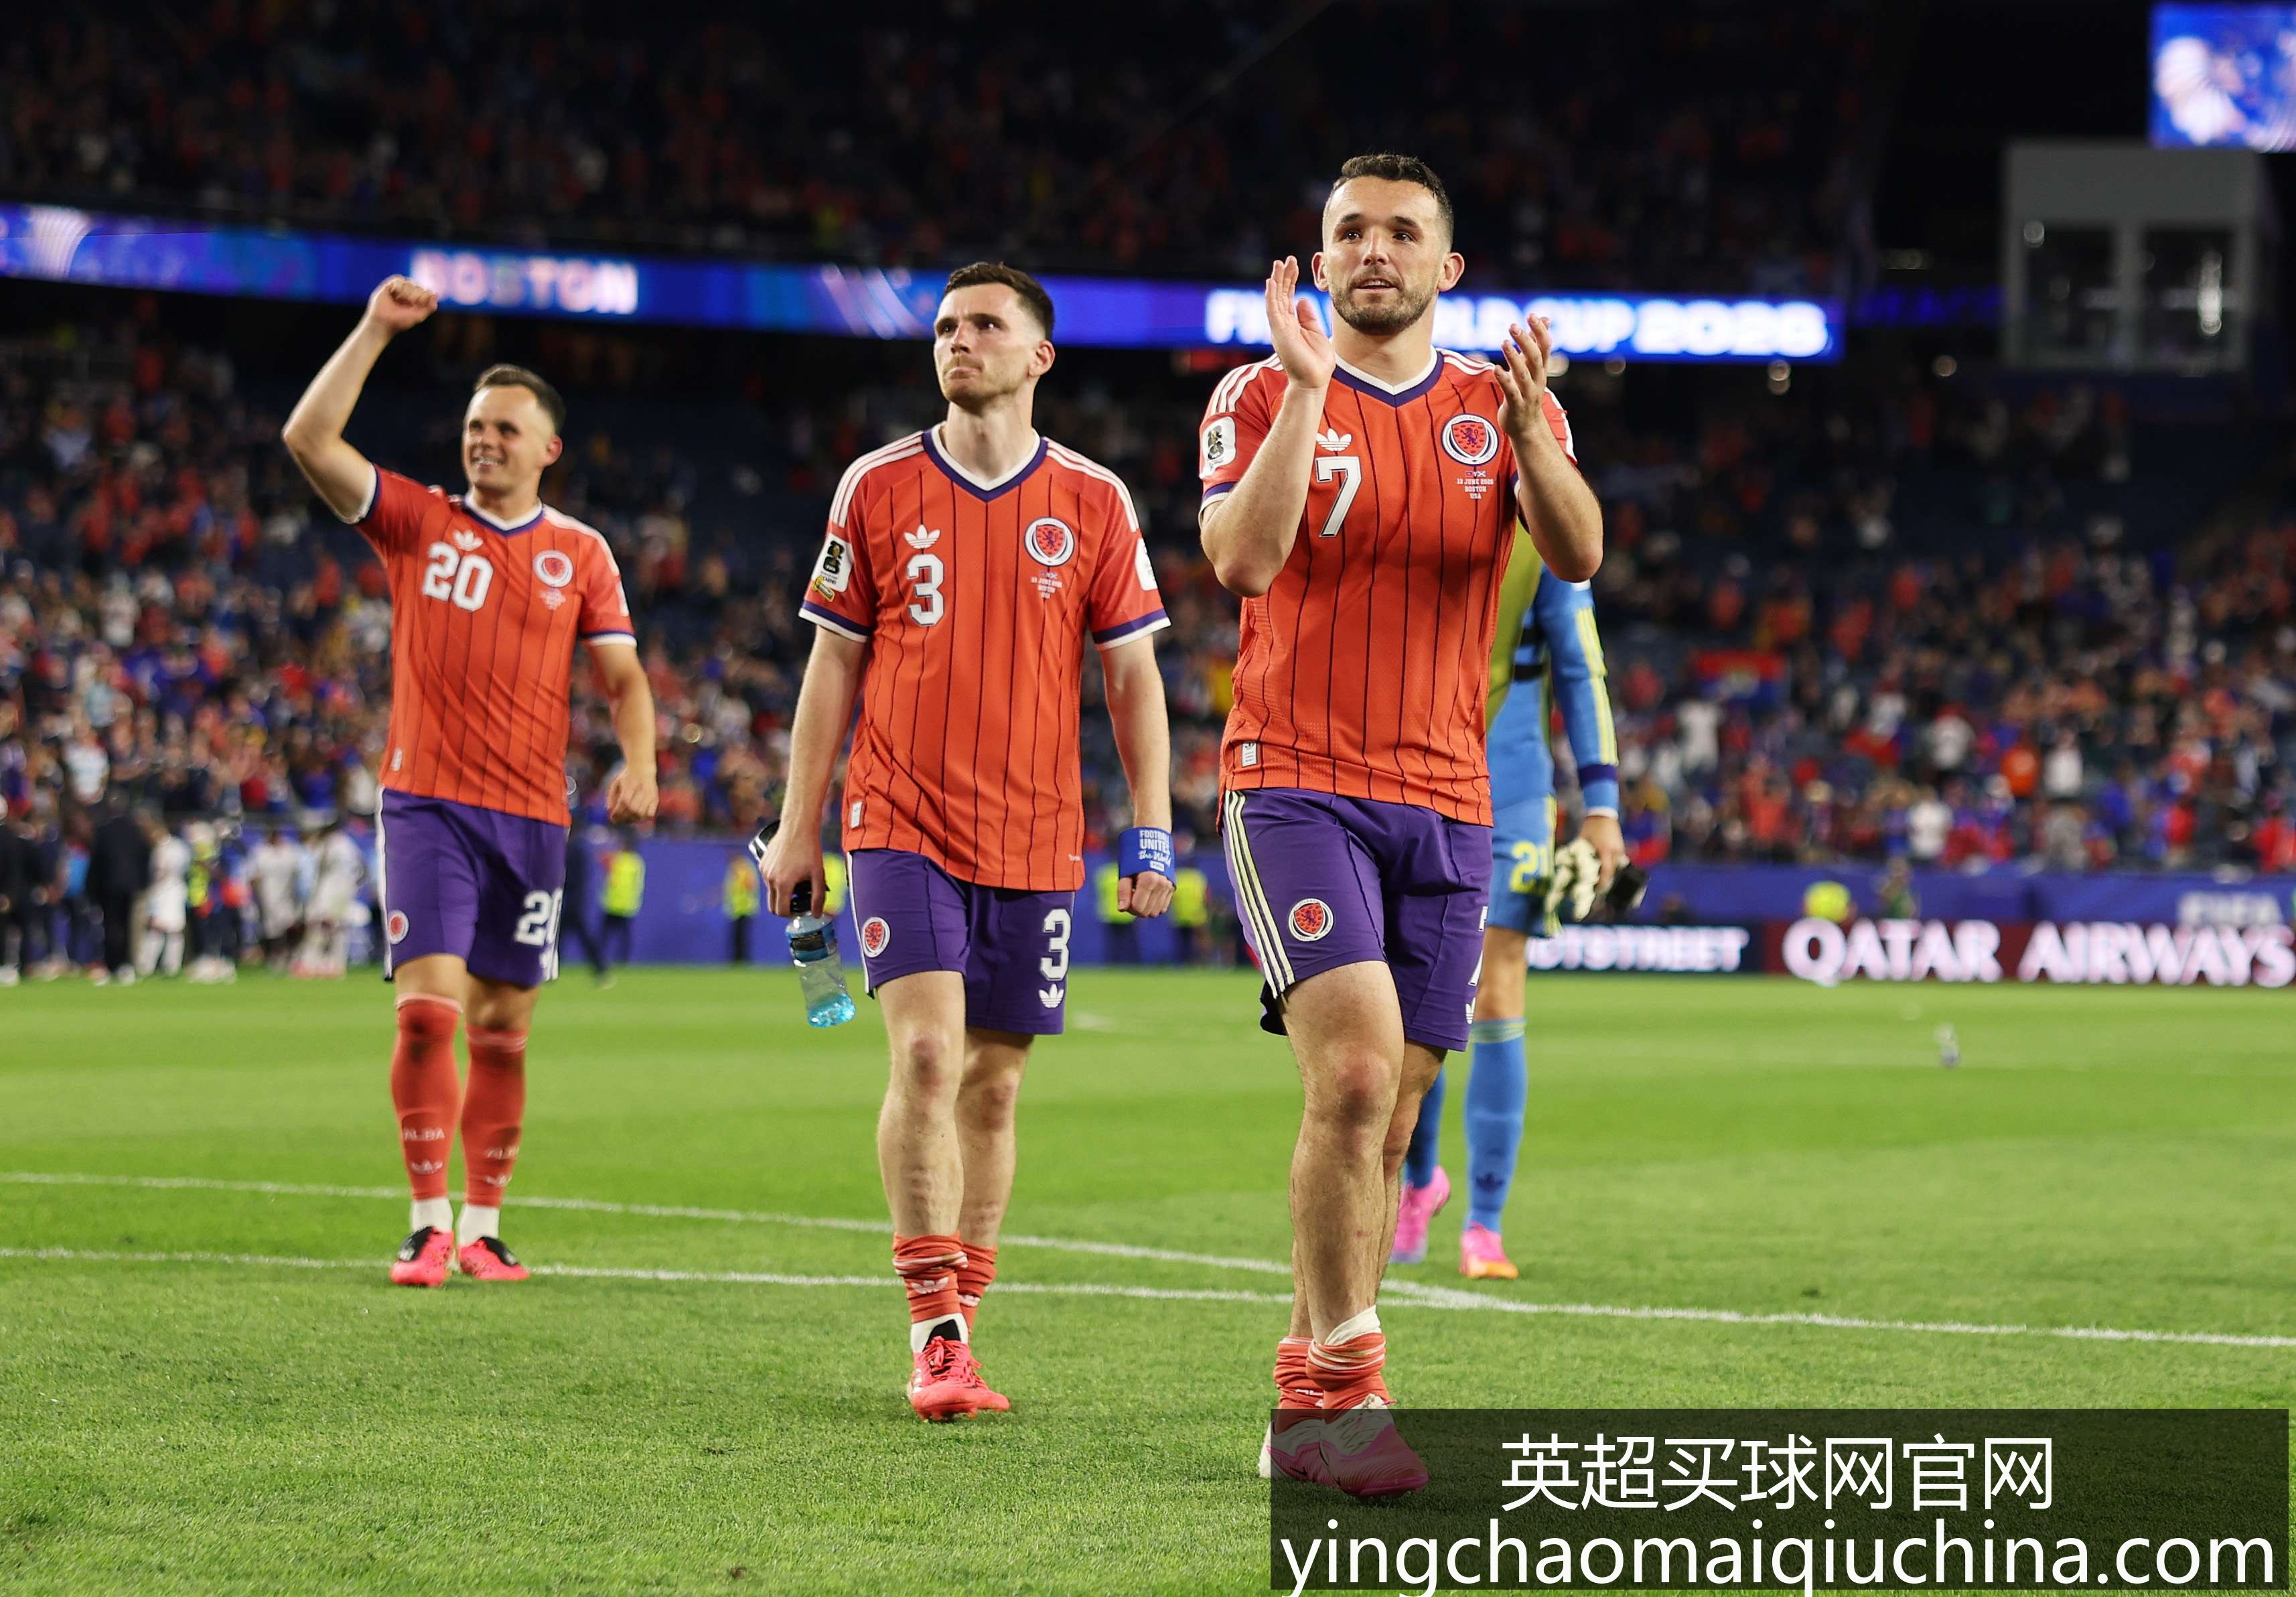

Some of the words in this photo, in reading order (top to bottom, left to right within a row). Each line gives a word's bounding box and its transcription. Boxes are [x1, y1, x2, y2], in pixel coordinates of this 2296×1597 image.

[1315, 456, 1362, 538] 7
[423, 541, 494, 612] 20
[907, 553, 944, 627] 3
[1040, 908, 1072, 981] 3
[1782, 917, 2003, 987] QATAR
[2017, 920, 2296, 988] AIRWAYS
